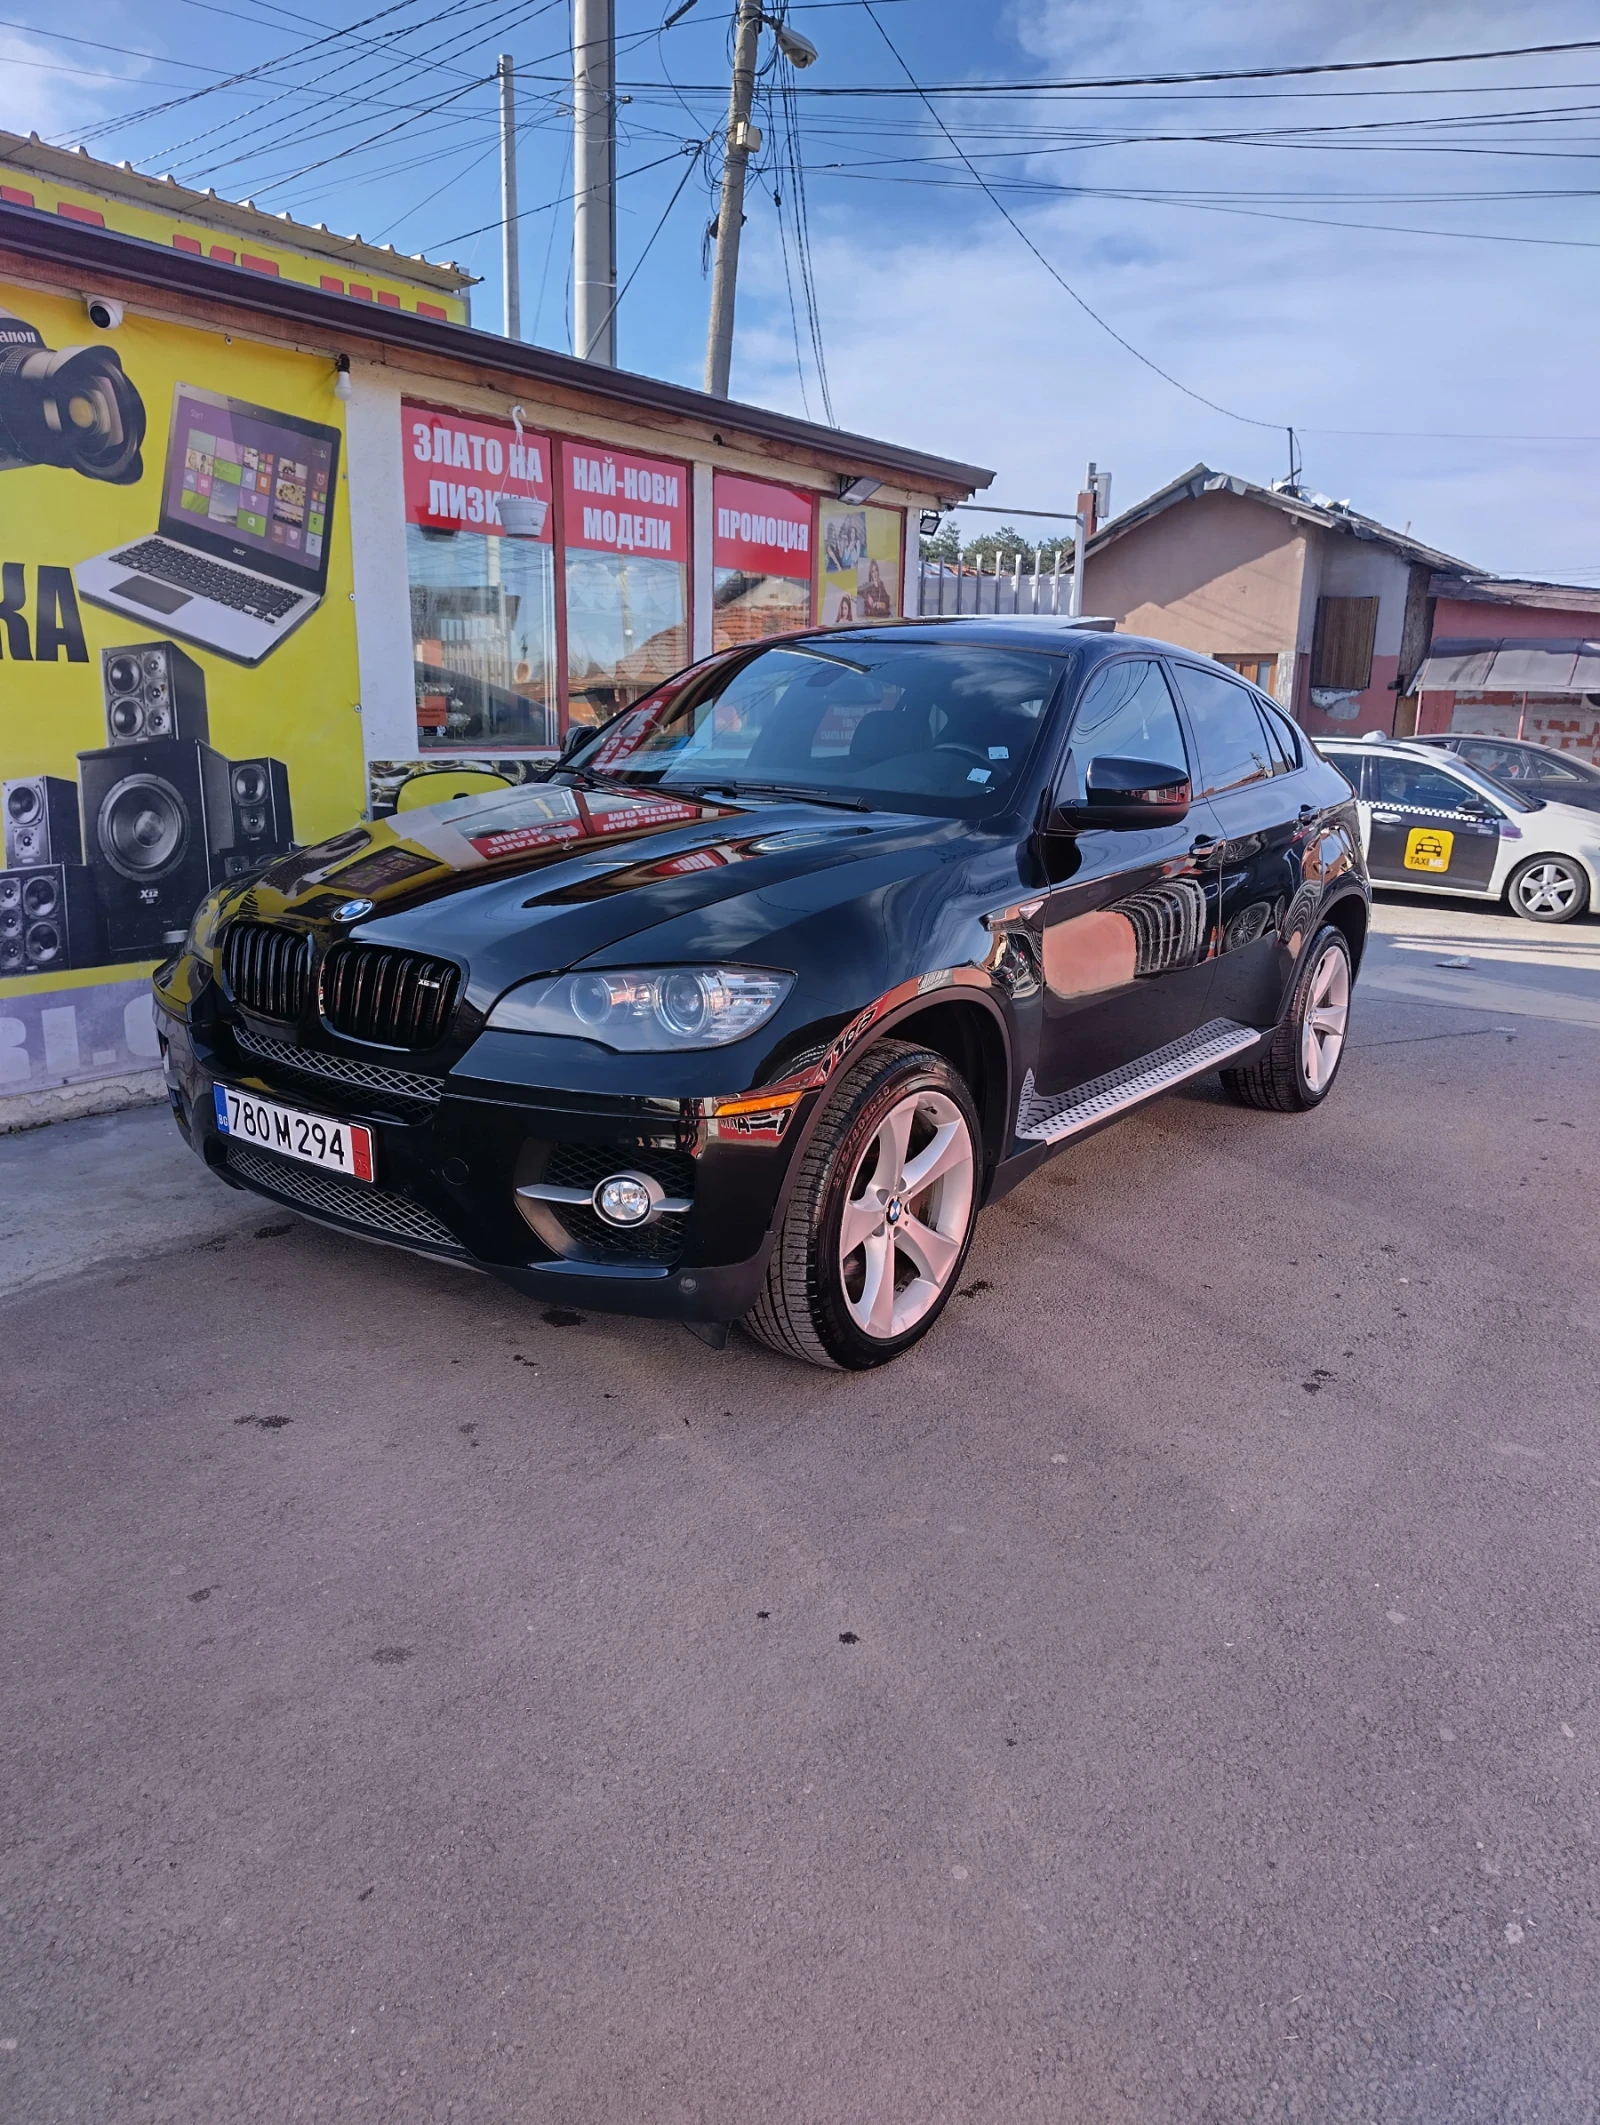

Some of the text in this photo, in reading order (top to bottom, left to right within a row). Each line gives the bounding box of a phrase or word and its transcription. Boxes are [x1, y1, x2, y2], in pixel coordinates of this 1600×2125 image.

[412, 423, 544, 484] ЗЛАТО НА
[428, 479, 531, 526] ЛИЗИ
[572, 456, 679, 508] НАЙ-НОВИ
[583, 507, 671, 551] МОДЕЛИ
[718, 508, 809, 553] ПРОМОЦИЯ
[232, 547, 247, 557] acer
[218, 1113, 228, 1126] BG
[228, 1096, 345, 1165] 780 M 294
[356, 1159, 368, 1173] 25
